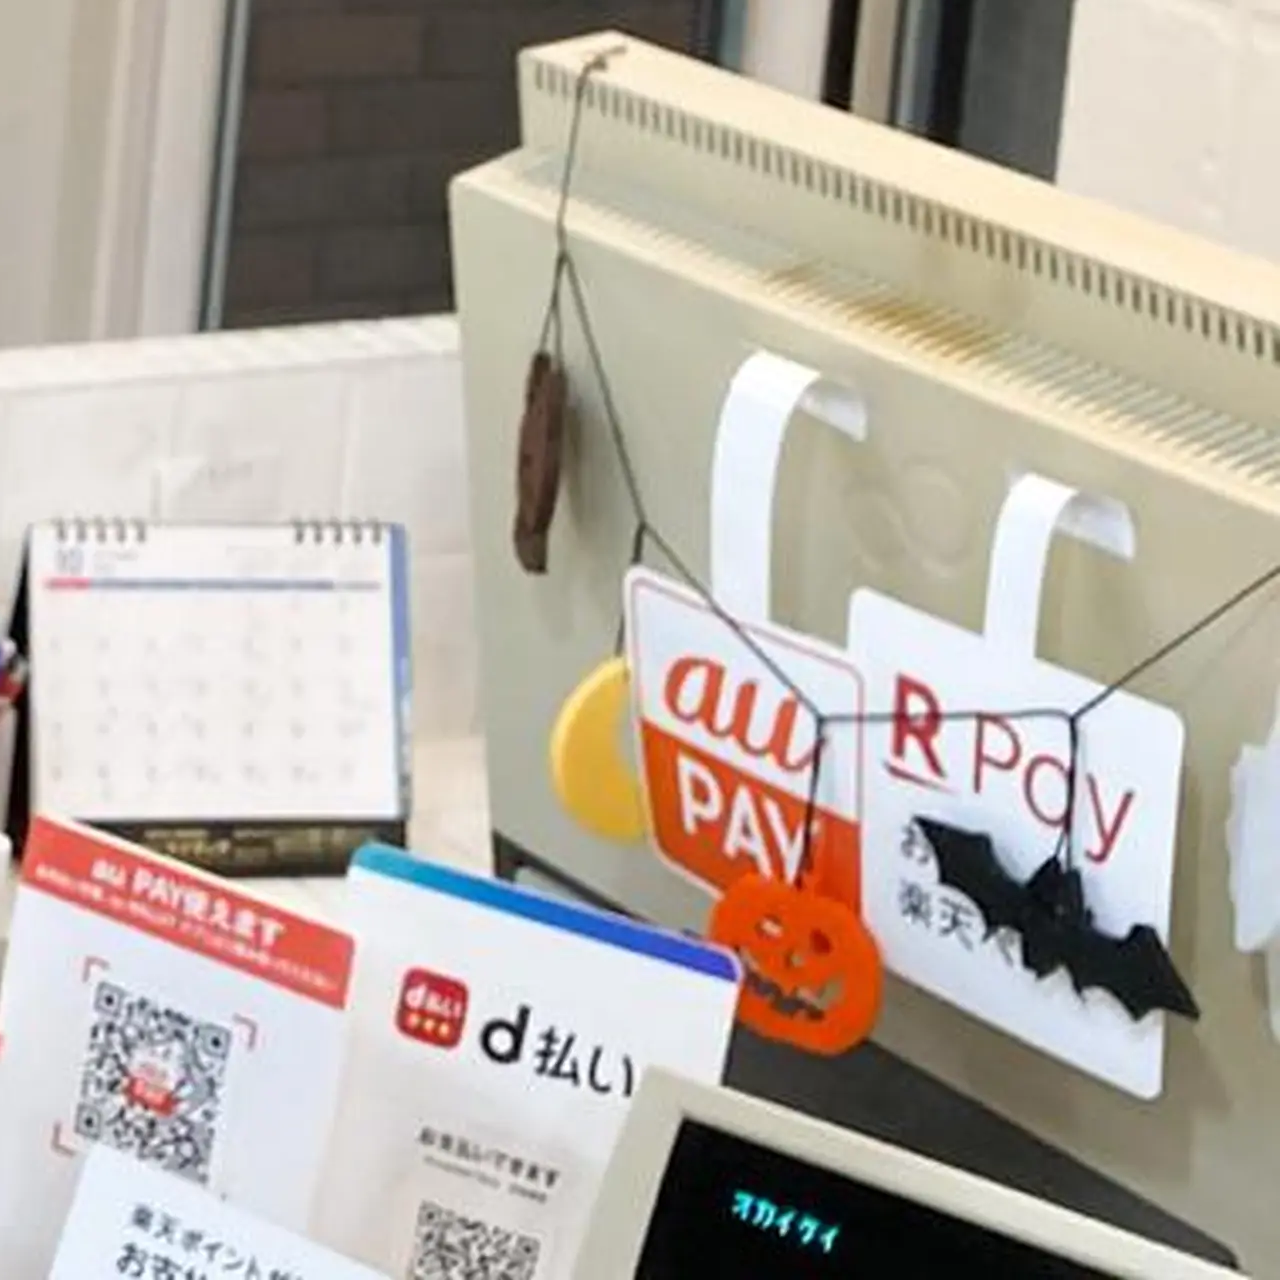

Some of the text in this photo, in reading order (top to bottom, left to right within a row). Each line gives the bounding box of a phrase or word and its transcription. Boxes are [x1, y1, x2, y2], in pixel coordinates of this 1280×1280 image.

[663, 655, 817, 772] au
[676, 754, 821, 888] PAY
[480, 1004, 634, 1099] d払い
